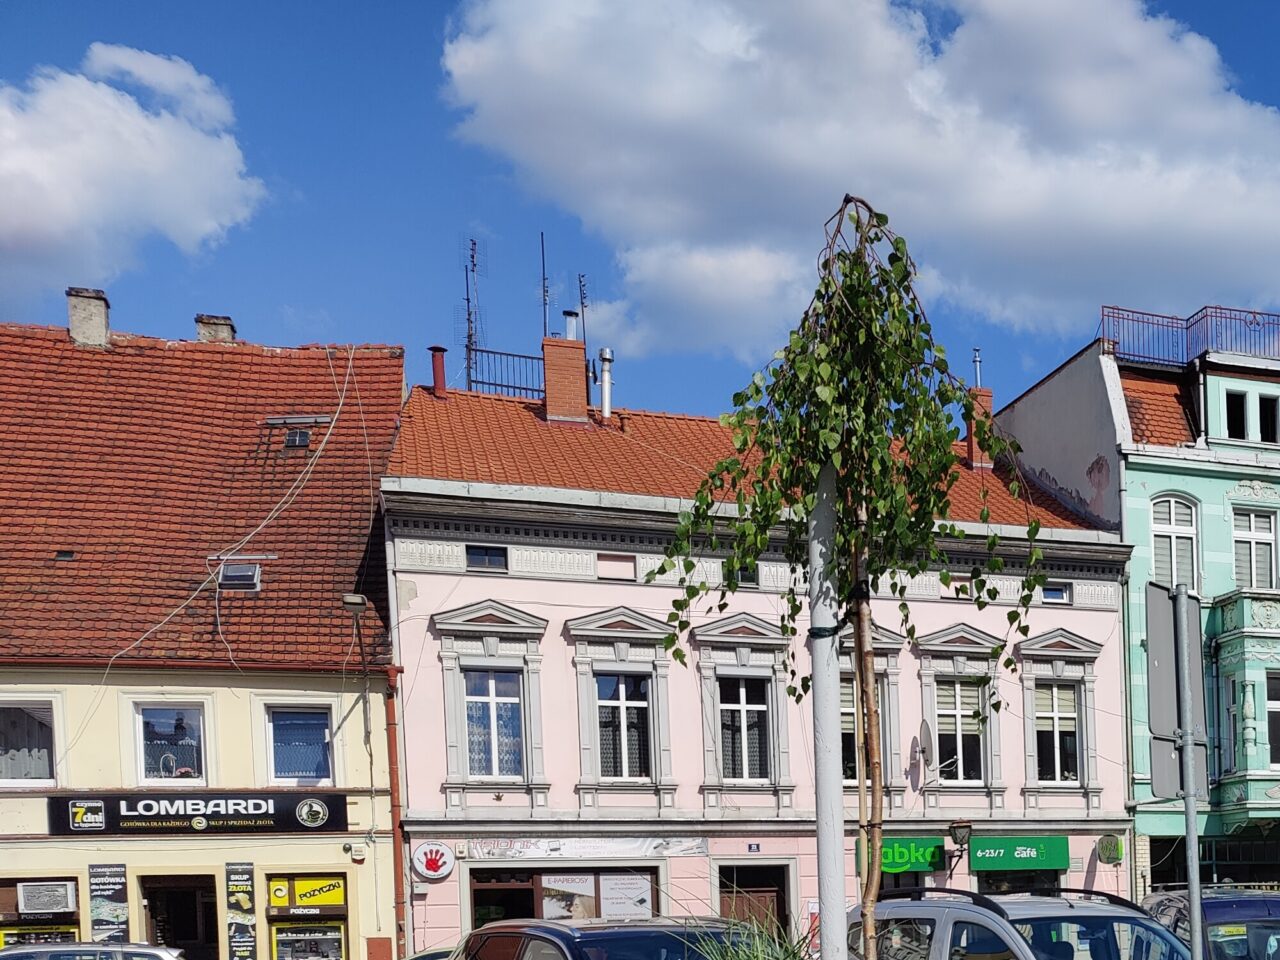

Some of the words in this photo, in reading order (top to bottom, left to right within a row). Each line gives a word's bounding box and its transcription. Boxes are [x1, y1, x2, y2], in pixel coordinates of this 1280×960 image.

[120, 799, 275, 816] LOMBARDI
[71, 807, 86, 823] 7
[82, 812, 103, 823] dni
[120, 819, 150, 827] GOTÓWKA
[162, 819, 190, 827] KAŻDEGO
[868, 843, 939, 863] abka
[976, 849, 1005, 857] 6-23/7
[90, 876, 126, 884] GOTÓWKA
[547, 877, 589, 885] E-PAPIEROSY
[298, 881, 341, 901] POŻYCZKI
[290, 906, 320, 914] POŻYCZKI
